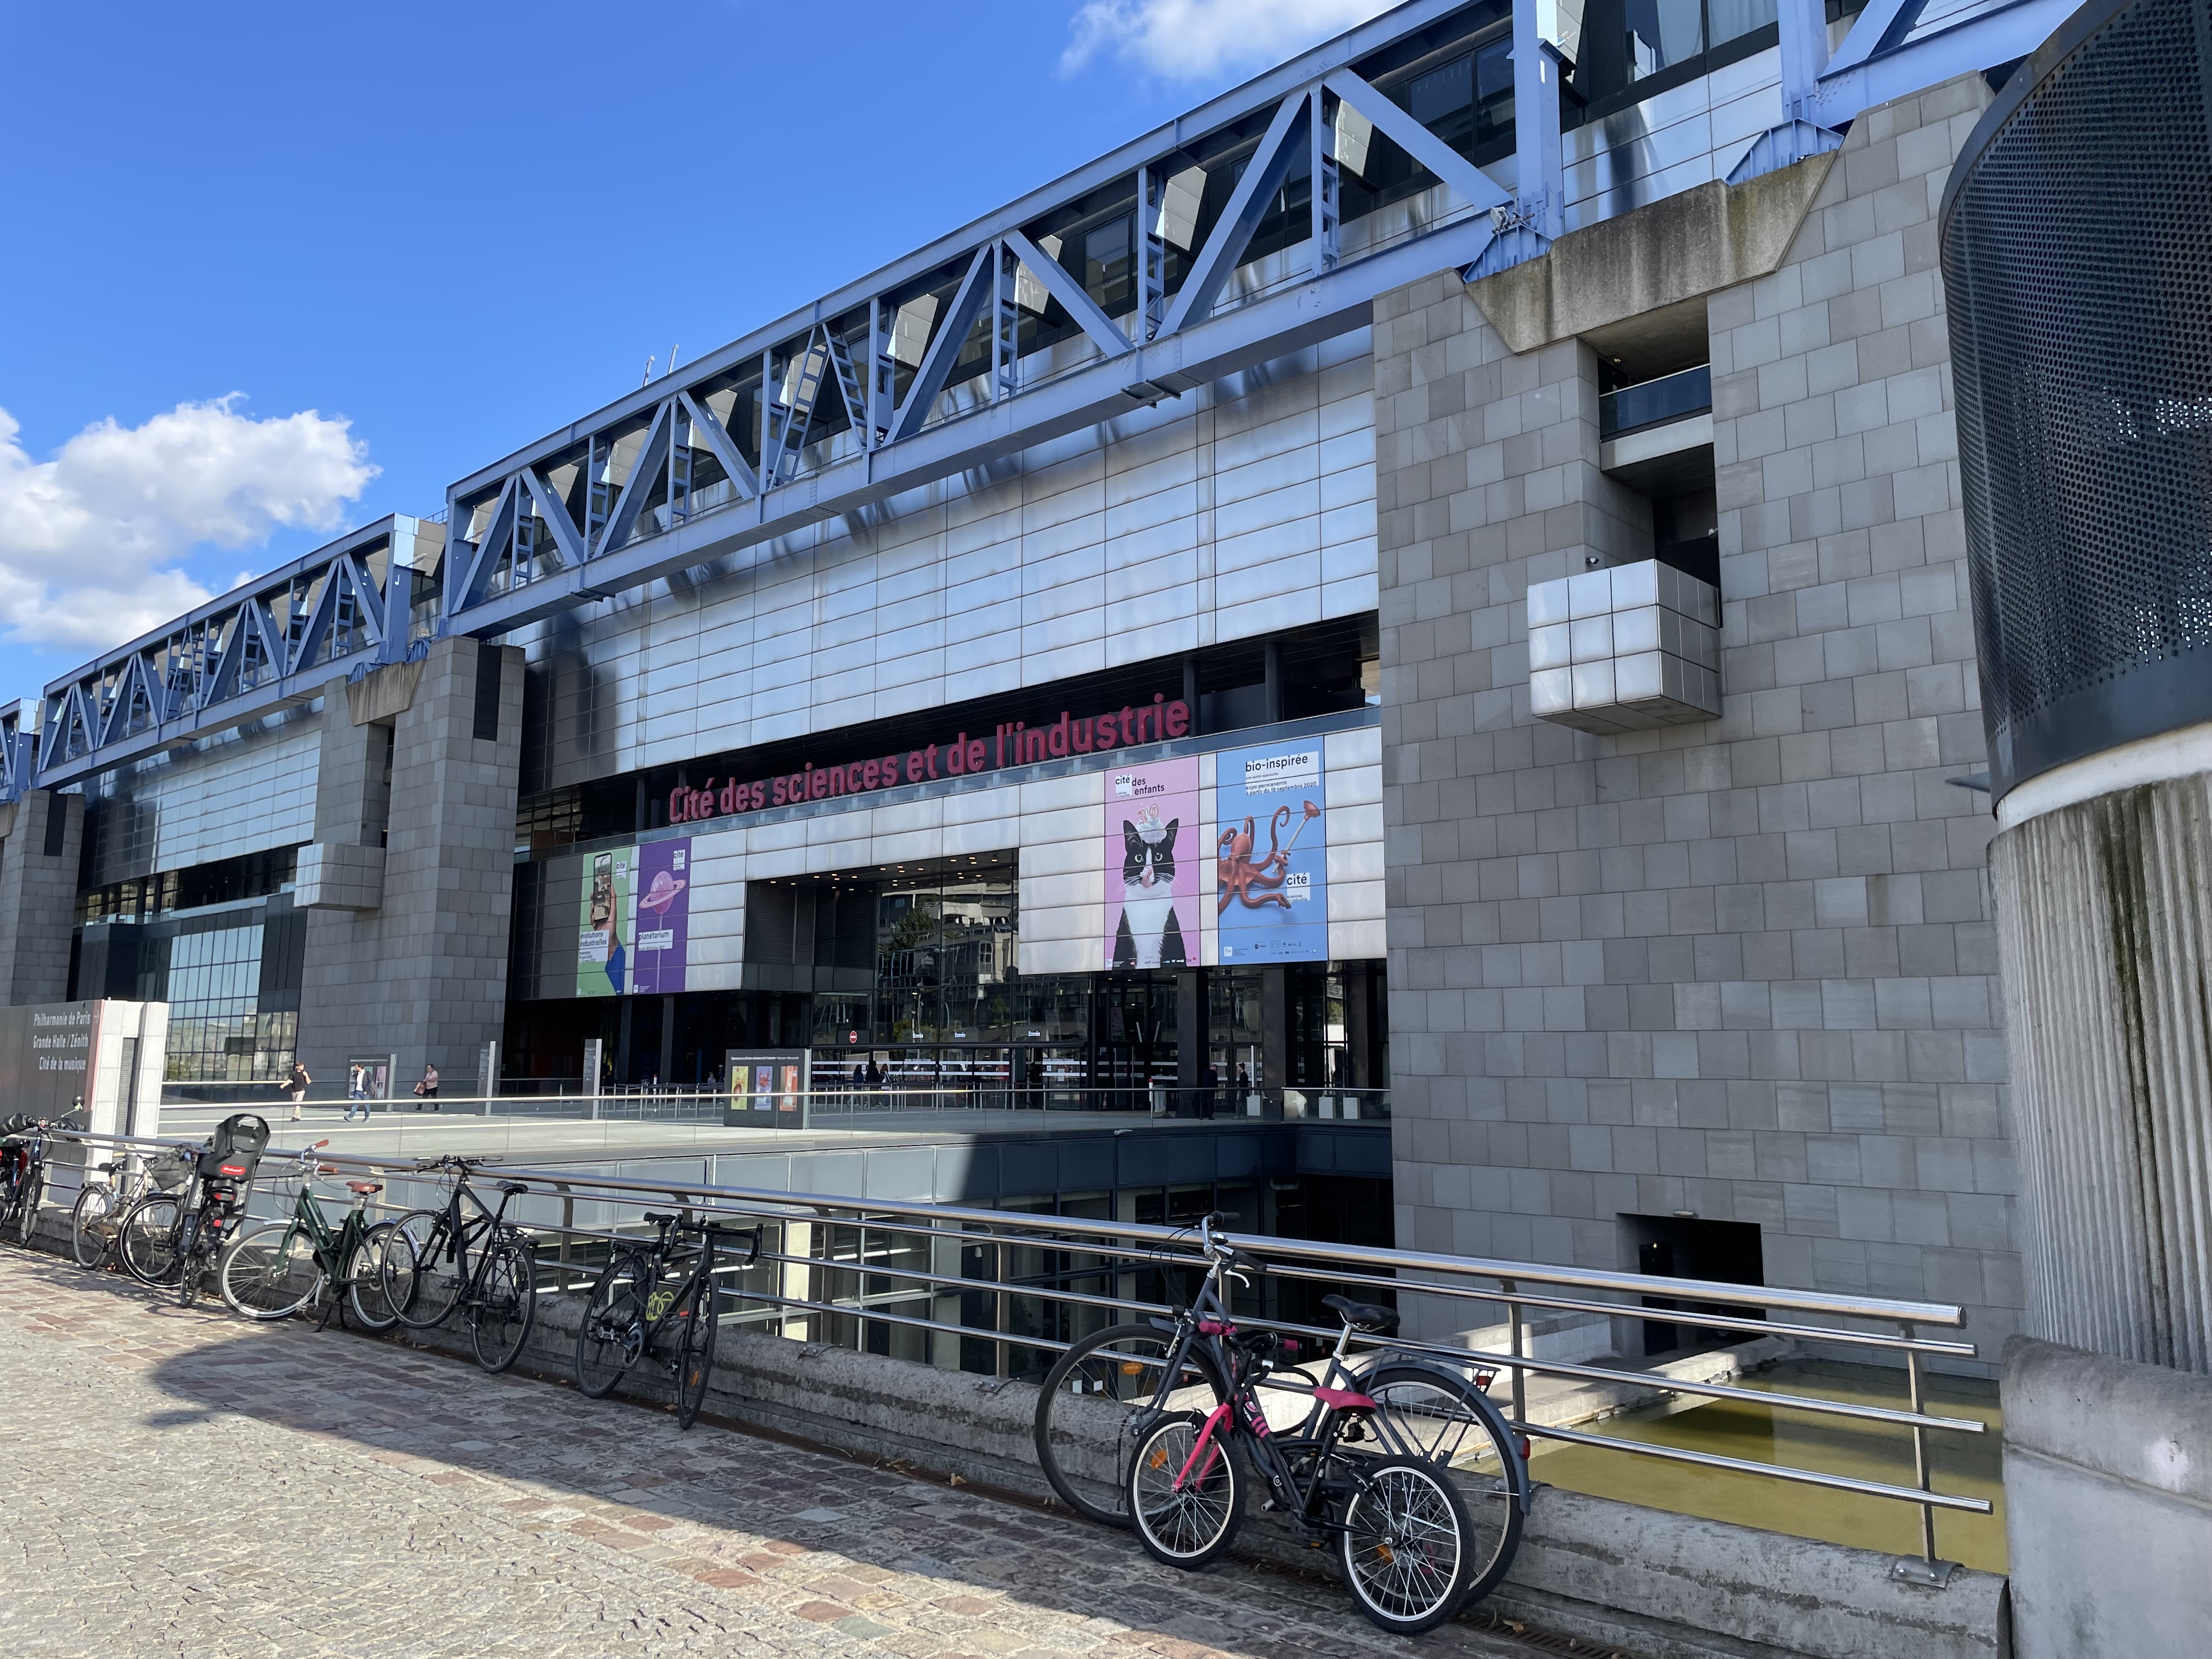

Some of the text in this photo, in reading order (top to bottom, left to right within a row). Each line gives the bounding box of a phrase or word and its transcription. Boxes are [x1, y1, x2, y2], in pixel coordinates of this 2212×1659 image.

[669, 693, 1190, 823] Cité des sciences et de l'industrie
[1245, 754, 1308, 772] bio-inspirée
[1115, 774, 1146, 786] cité des
[1258, 781, 1287, 789] permanente
[1135, 784, 1165, 795] enfants
[1277, 784, 1303, 792] septembre
[673, 850, 684, 859] cité
[1286, 872, 1307, 885] cité
[33, 1011, 91, 1026] Philharmonie de Paris
[33, 1035, 52, 1049] Grande
[52, 1034, 66, 1048] Halle
[70, 1032, 88, 1048] Zénith
[39, 1056, 86, 1074] Cité de la musique
